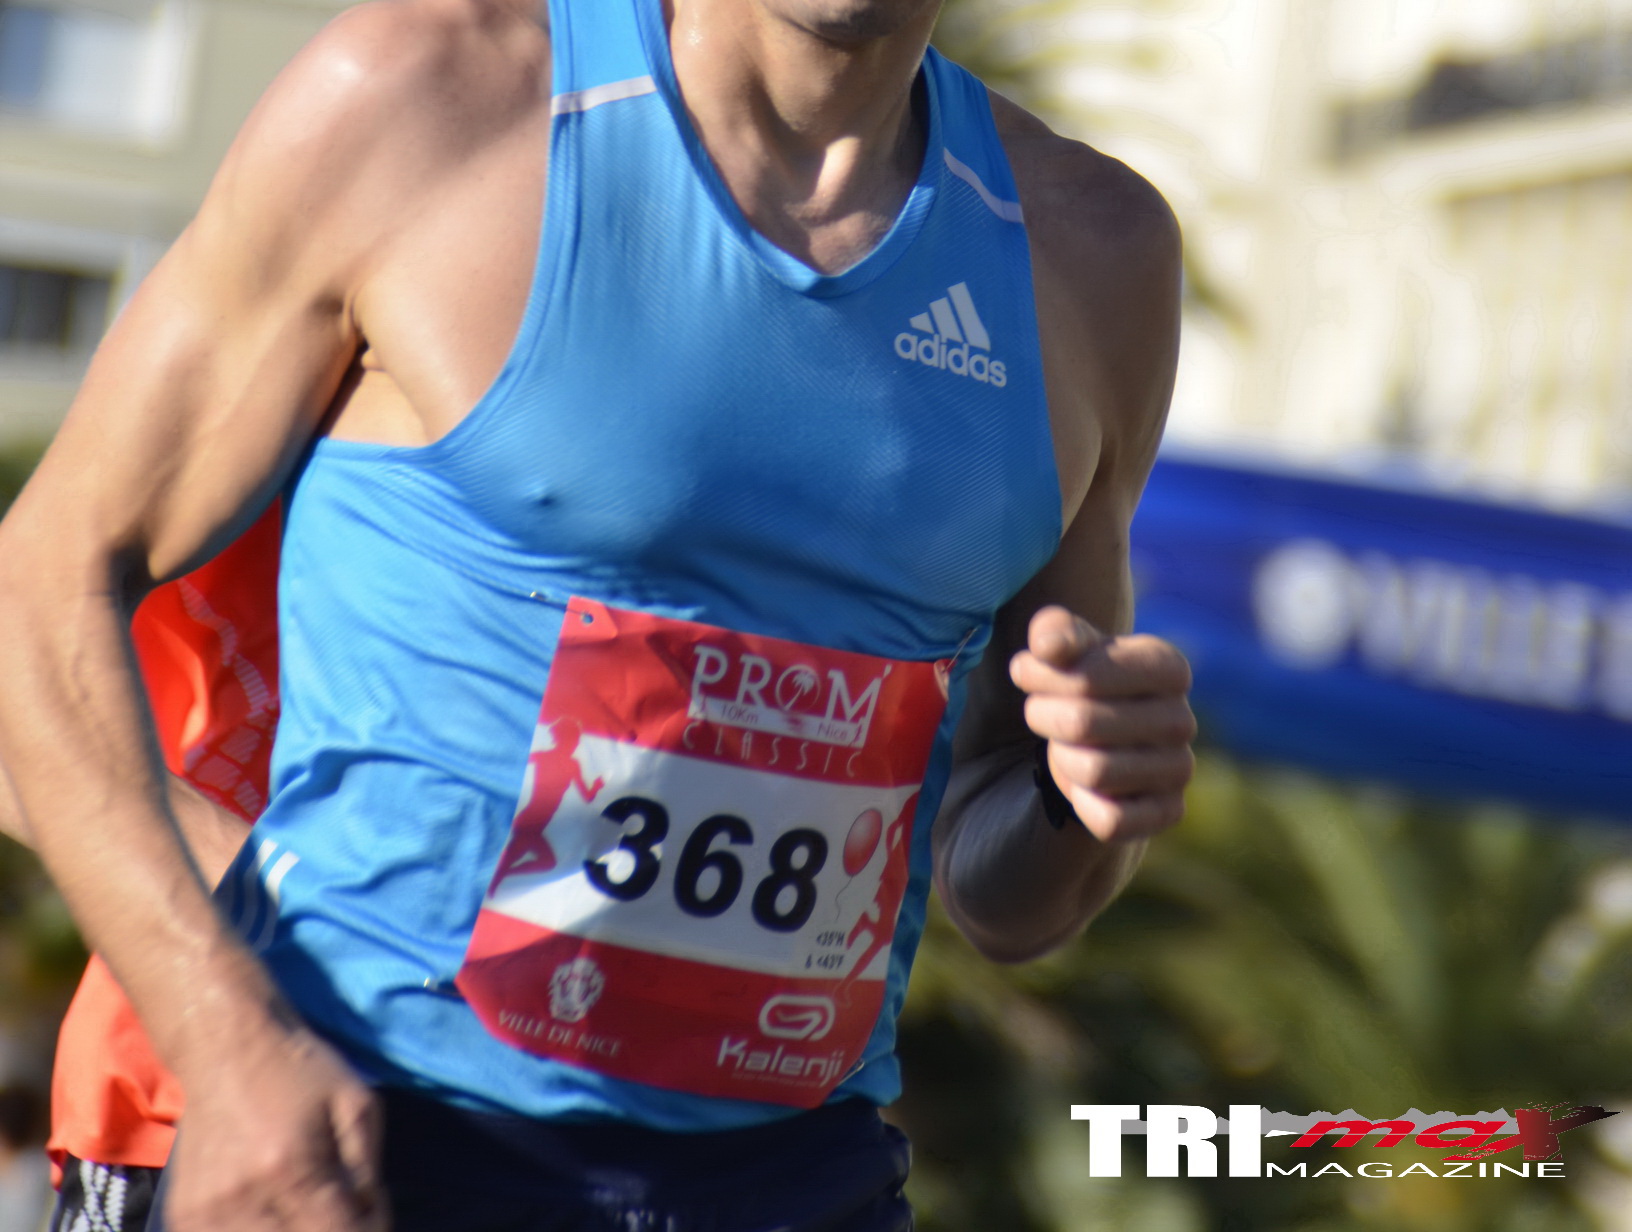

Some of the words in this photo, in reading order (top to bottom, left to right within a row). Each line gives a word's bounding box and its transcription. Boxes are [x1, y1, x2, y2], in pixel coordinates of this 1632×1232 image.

[894, 332, 1007, 388] adidas
[682, 718, 863, 778] CLASSIC
[583, 795, 829, 934] 368
[546, 1024, 574, 1046] DE
[575, 1032, 622, 1058] NICE
[716, 1035, 845, 1088] Kalenji
